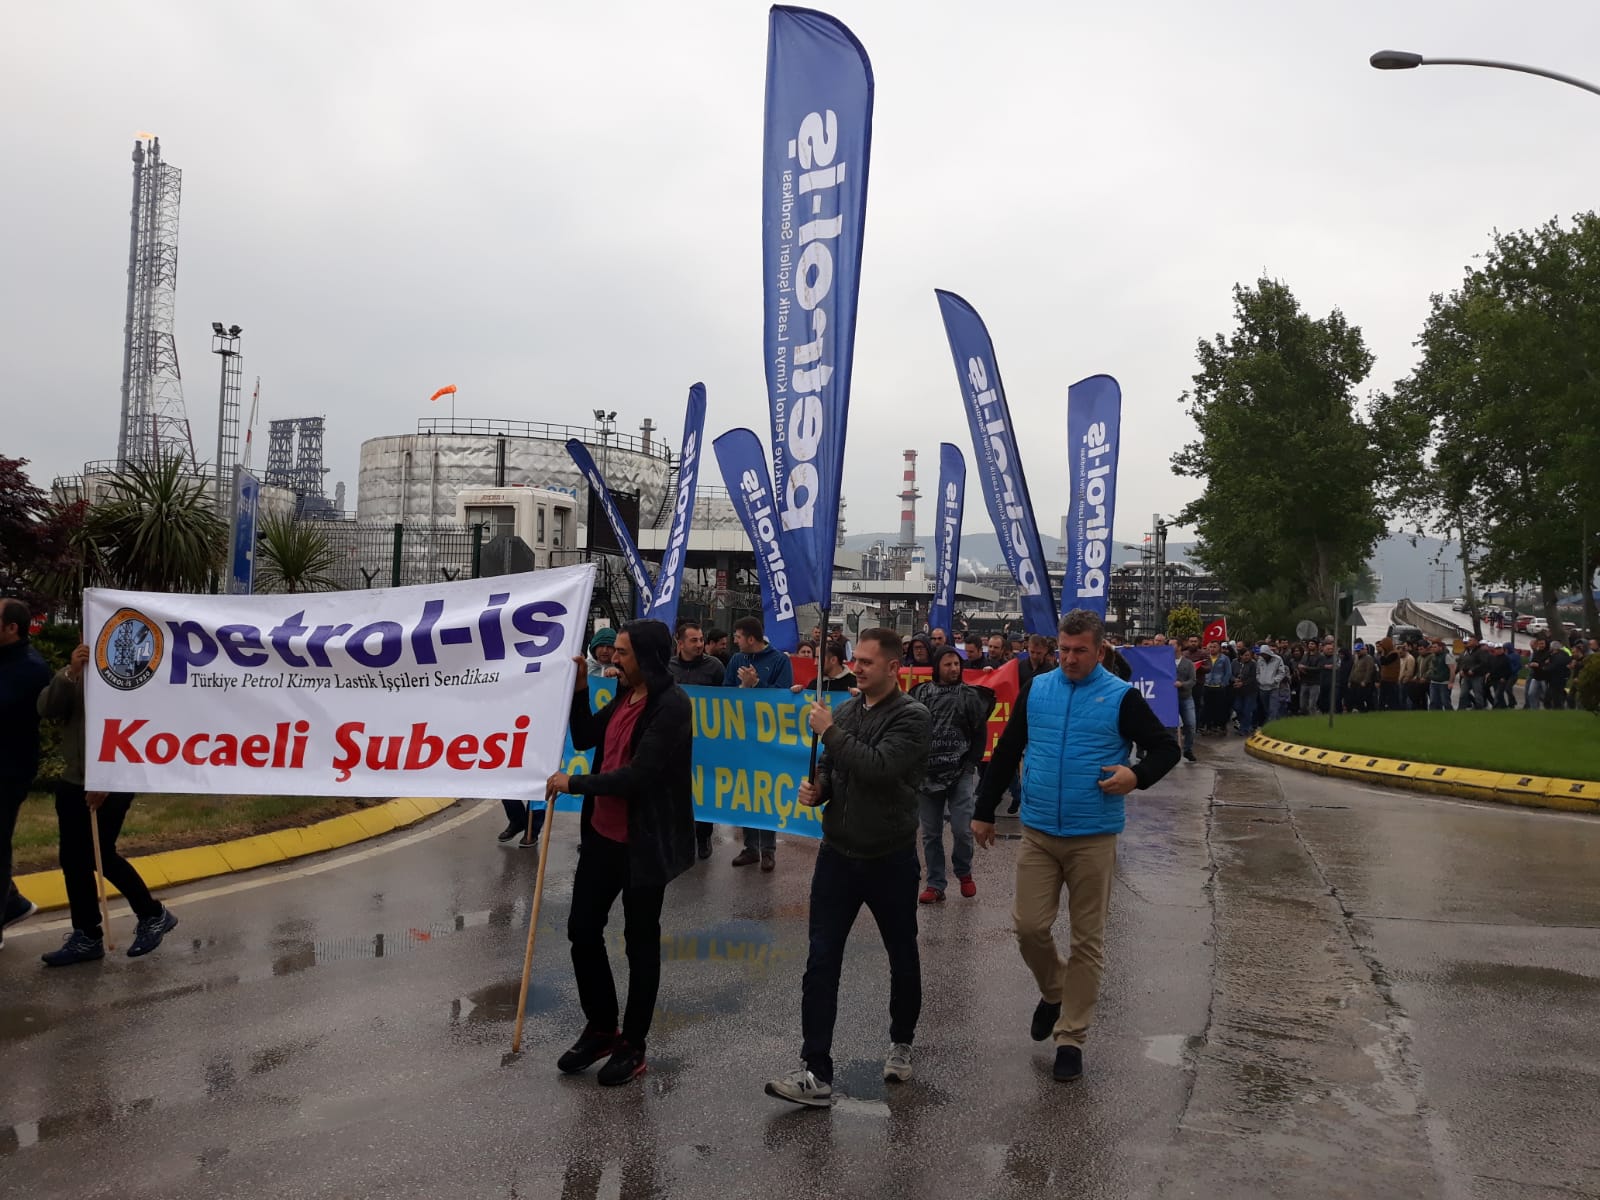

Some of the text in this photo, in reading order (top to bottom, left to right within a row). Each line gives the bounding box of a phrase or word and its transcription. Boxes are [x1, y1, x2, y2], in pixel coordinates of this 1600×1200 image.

[852, 582, 861, 591] 6A
[165, 593, 568, 684] petrol-iş
[191, 668, 500, 693] Türkiye Petrol Kimya Lastik İşçileri Sendikası
[97, 718, 310, 768] Kocaeli
[332, 714, 532, 782] Şubesi
